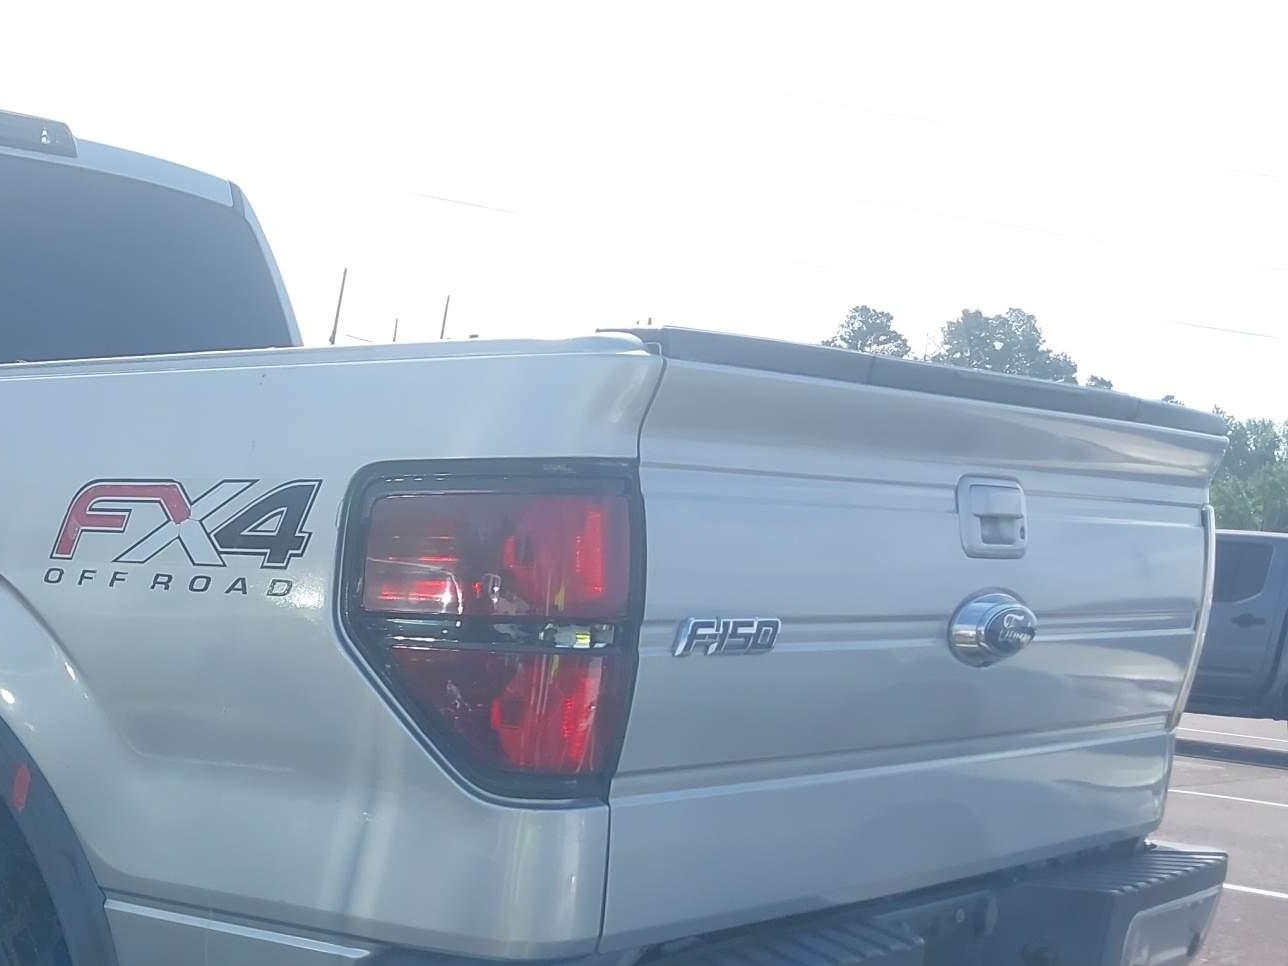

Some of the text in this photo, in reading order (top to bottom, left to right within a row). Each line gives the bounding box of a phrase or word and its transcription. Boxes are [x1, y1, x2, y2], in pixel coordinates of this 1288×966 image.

[49, 478, 323, 569] FX4
[43, 567, 293, 597] OFF ROAD
